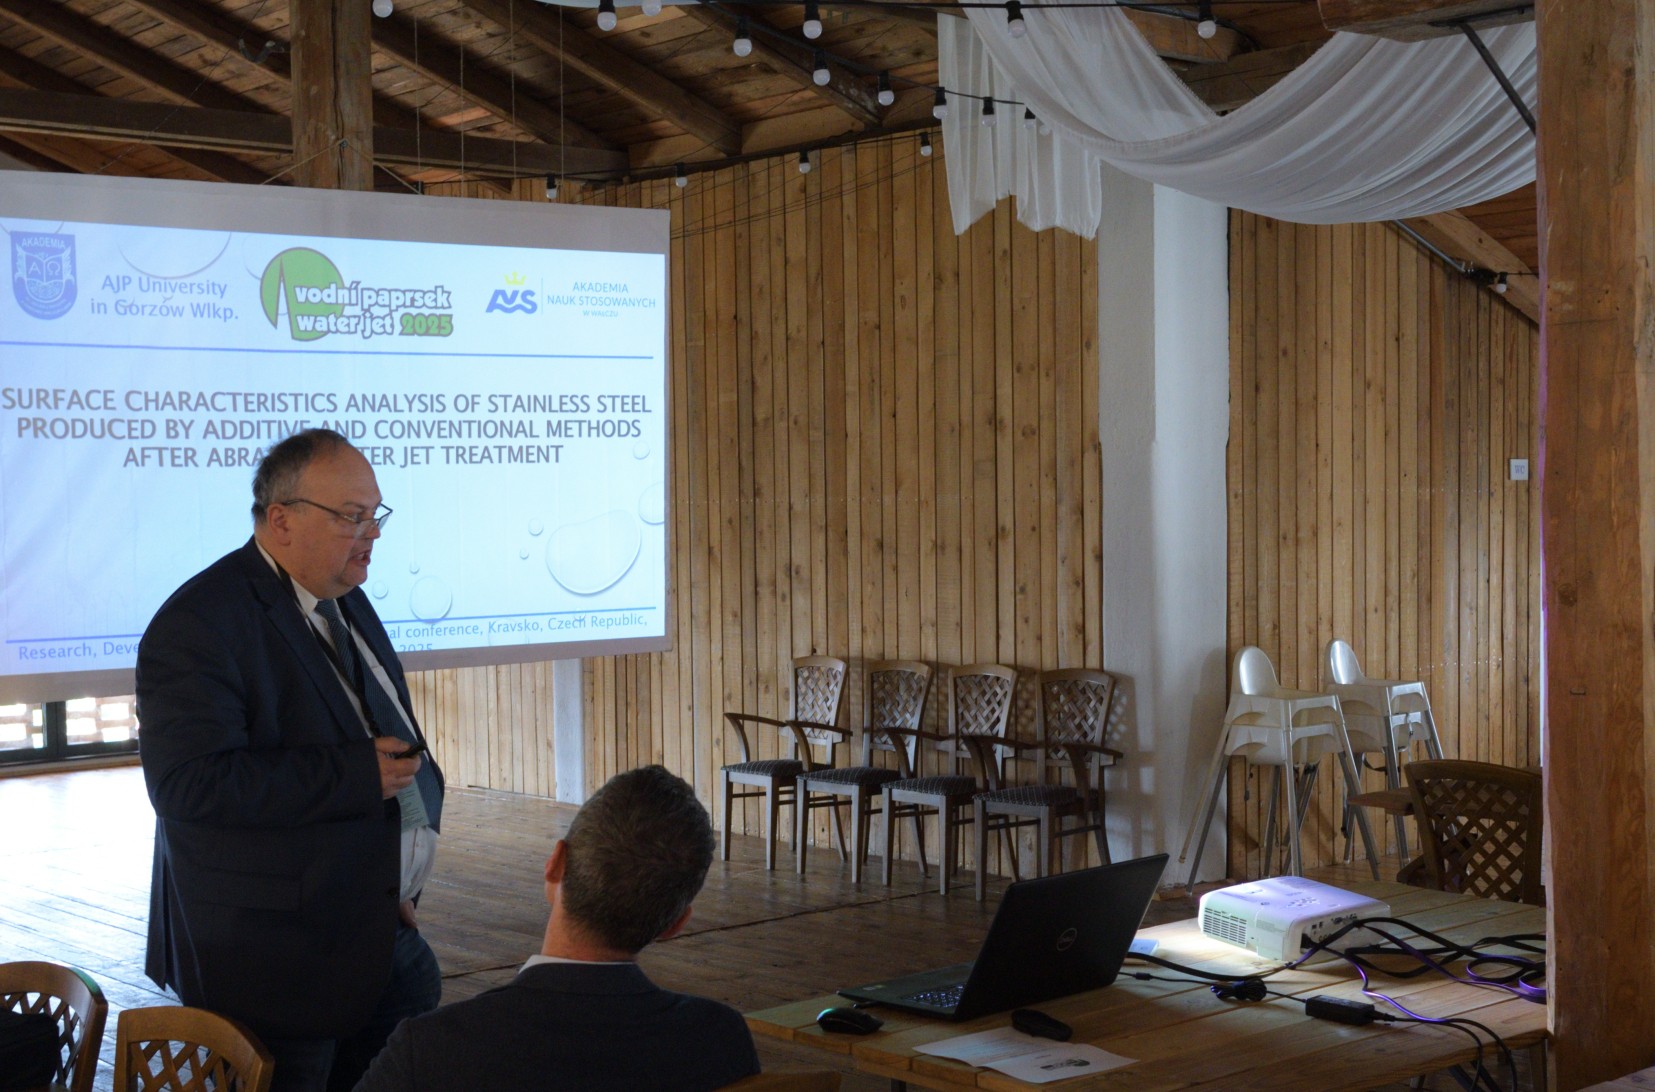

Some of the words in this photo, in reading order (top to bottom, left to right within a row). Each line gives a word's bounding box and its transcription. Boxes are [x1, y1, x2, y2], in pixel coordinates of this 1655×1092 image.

[21, 236, 66, 249] AKADEMIA
[101, 274, 132, 294] AJP
[138, 276, 228, 299] University
[294, 280, 361, 306] vodní
[360, 285, 452, 312] paprsek
[572, 281, 629, 294] AKADEMIA
[91, 298, 107, 314] in
[190, 302, 239, 323] Wlkp.
[547, 296, 576, 306] NAUK
[578, 296, 656, 309] STOSOWANYCH
[295, 313, 361, 335] water
[398, 312, 454, 337] 2025
[1, 387, 117, 411] SURFACE
[124, 390, 338, 413] CHARACTERISTICS
[344, 393, 447, 413] ANALYSIS
[452, 393, 481, 413] OF
[487, 394, 591, 413] STAINLESS
[596, 394, 653, 413] STEEL
[17, 417, 156, 440] PRODUCED
[166, 419, 195, 440] BY
[373, 420, 540, 440] CONVENTIONAL
[546, 419, 642, 438] METHODS
[123, 446, 199, 468] AFTER
[400, 446, 434, 468] JET
[441, 445, 564, 464] TREATMENT
[405, 621, 484, 639] conference,
[488, 619, 544, 635] Kravsko,
[547, 615, 586, 631] Czech
[590, 612, 648, 629] Republic,
[18, 642, 98, 661] Research,
